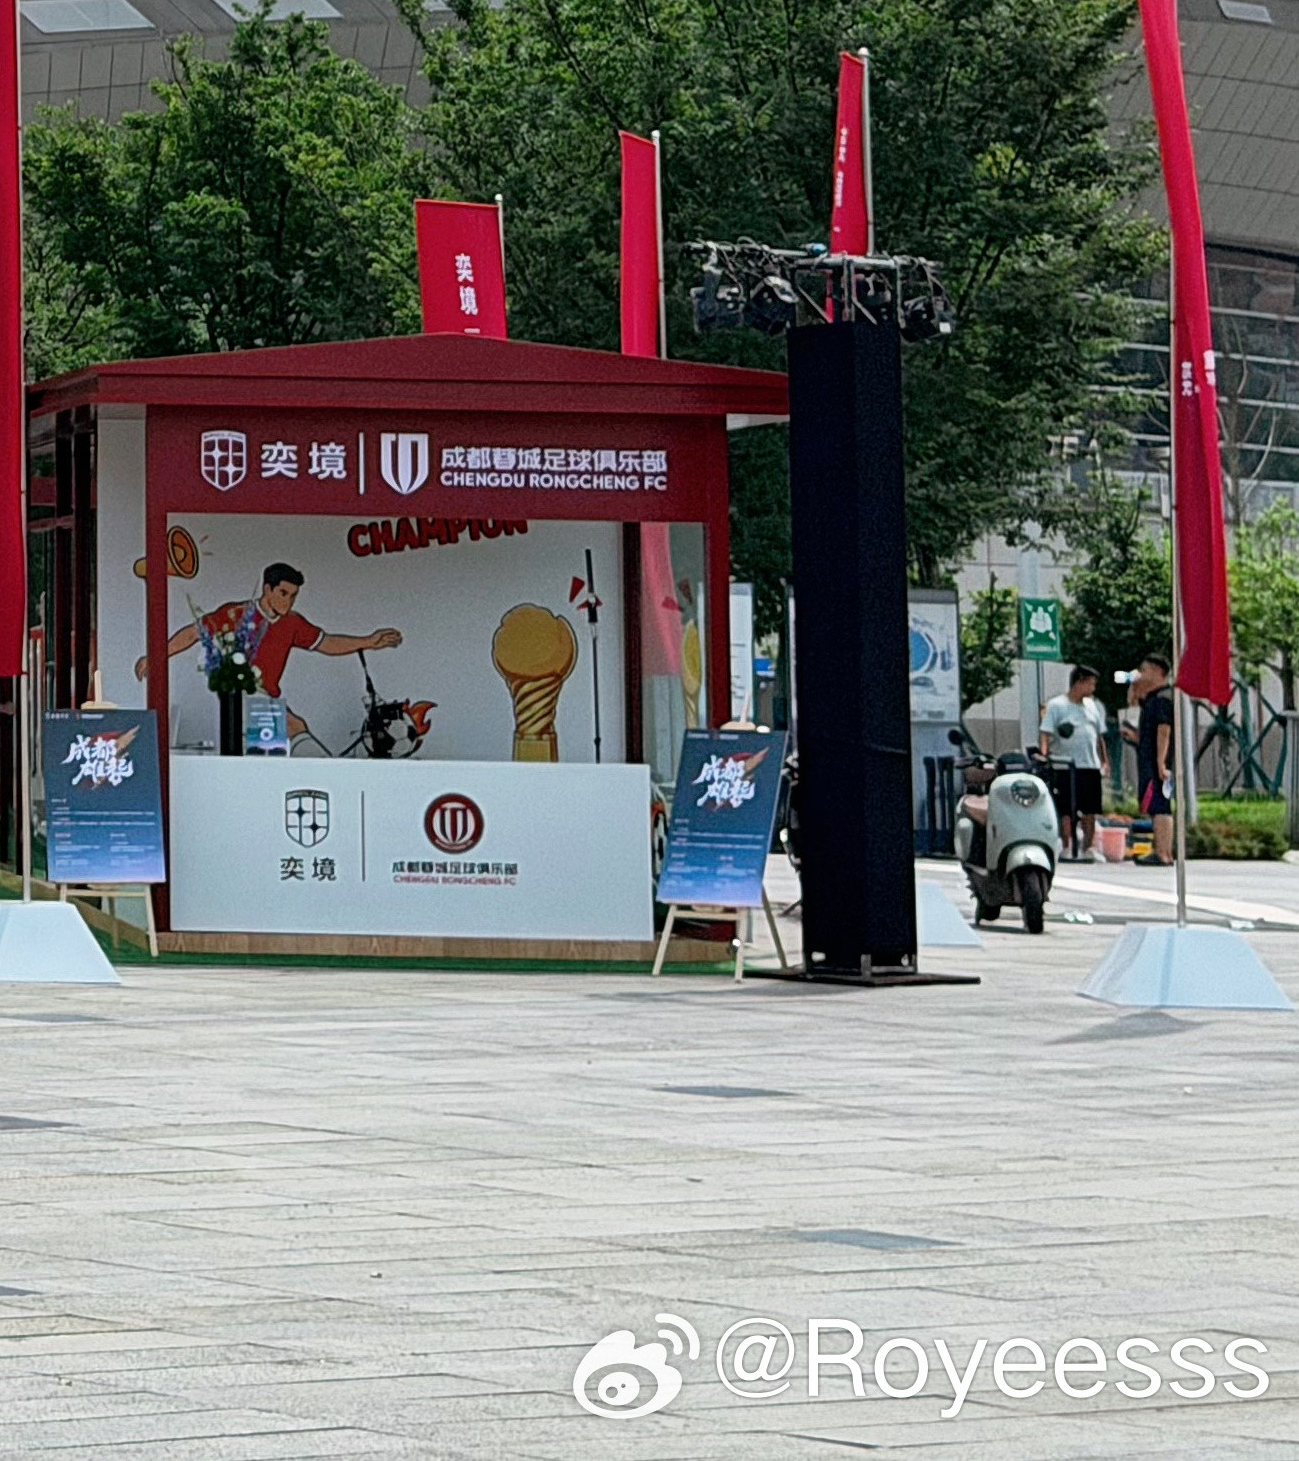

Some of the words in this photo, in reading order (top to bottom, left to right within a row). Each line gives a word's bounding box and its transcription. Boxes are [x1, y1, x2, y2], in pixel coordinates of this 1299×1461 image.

[261, 441, 347, 480] 奕境
[441, 446, 667, 473] 成都蓉城足球俱乐部
[440, 471, 525, 488] CHENGDU
[529, 473, 640, 490] RONGCHENG
[644, 475, 668, 491] FC
[280, 856, 337, 881] 奕境
